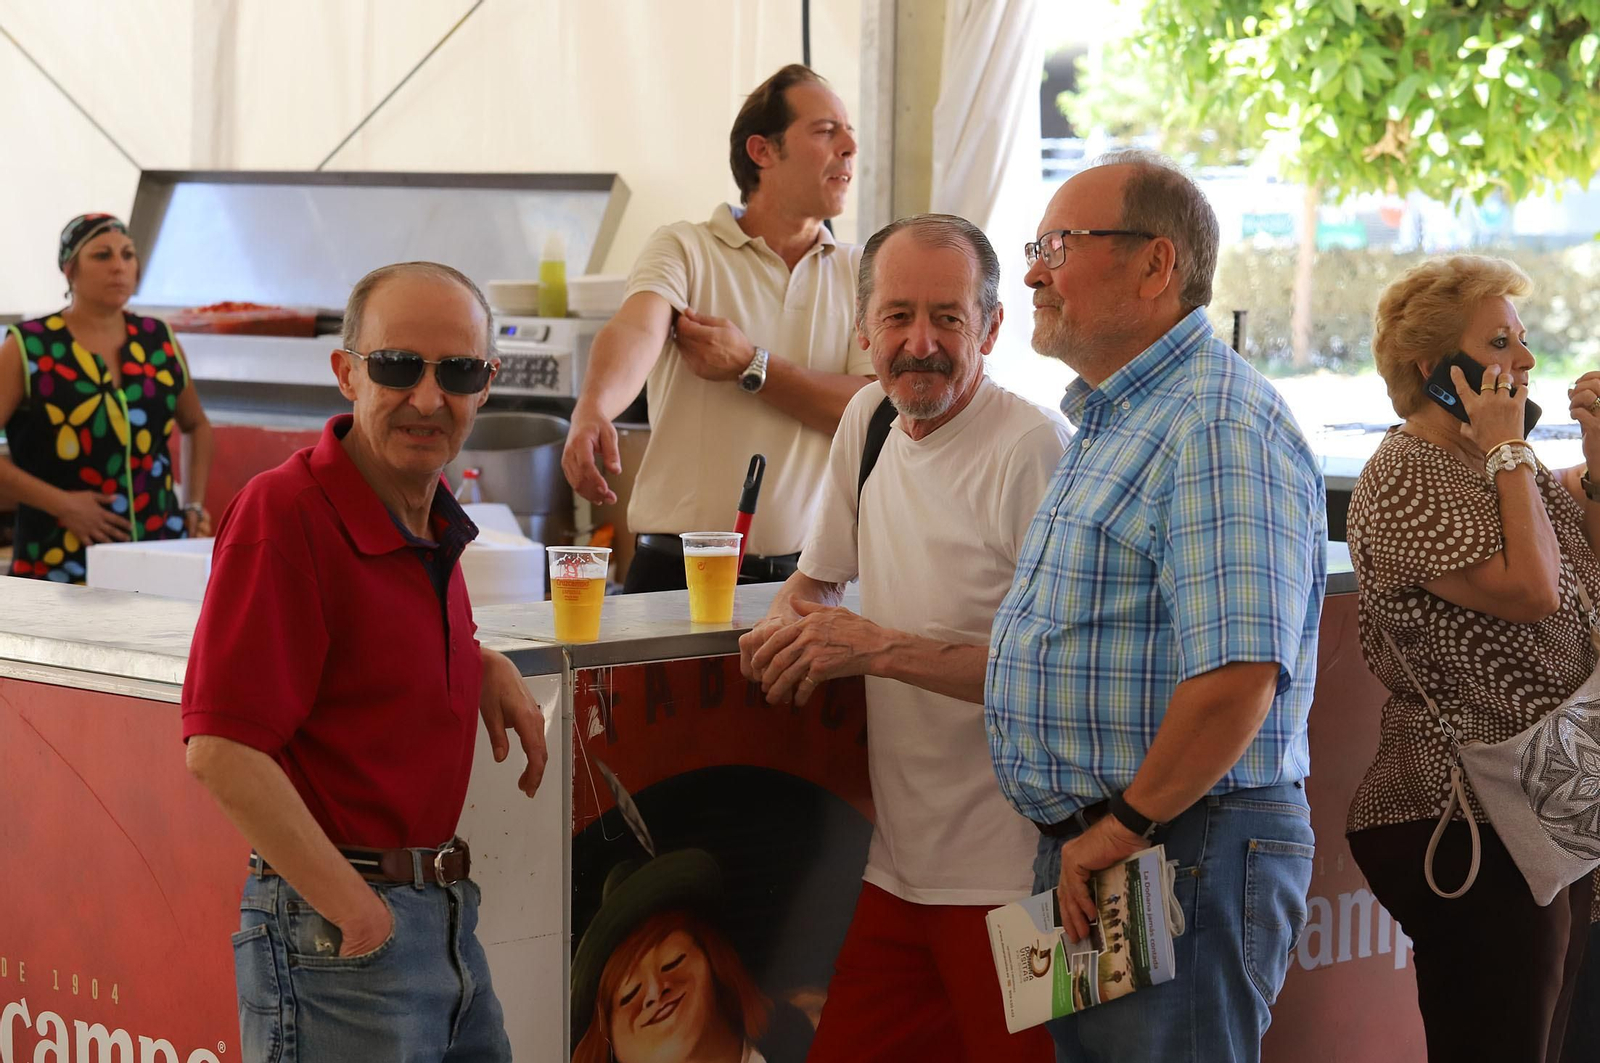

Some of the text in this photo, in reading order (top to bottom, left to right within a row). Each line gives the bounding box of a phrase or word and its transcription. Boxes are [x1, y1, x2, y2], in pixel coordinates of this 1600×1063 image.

[1143, 870, 1159, 969] La Doñana jamás contada
[53, 970, 119, 1005] 1904
